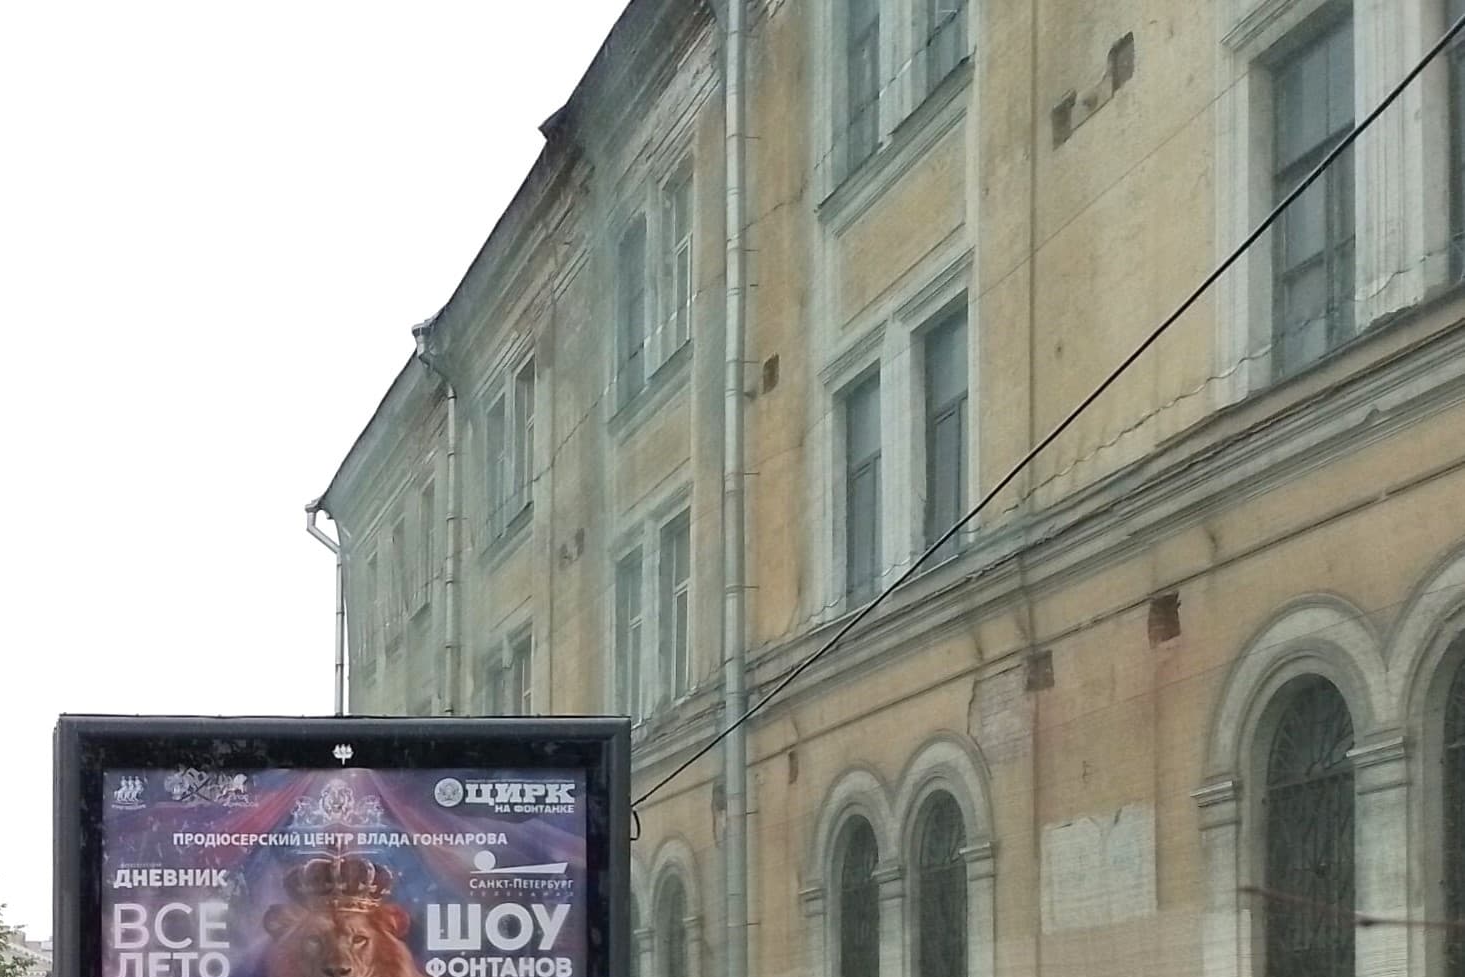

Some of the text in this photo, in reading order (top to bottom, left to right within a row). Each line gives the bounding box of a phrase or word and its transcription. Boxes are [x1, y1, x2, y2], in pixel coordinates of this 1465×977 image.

[465, 783, 575, 806] ЦИРК
[495, 804, 574, 813] НА ФОНТАНКЕ
[173, 832, 508, 848] ПРОДЮСЕРСКИЙ ЦЕНТР ВЛАДА ГОНЧАРОВА
[113, 868, 228, 889] ДНЕВНИК
[114, 902, 230, 949] ВСЕ
[427, 902, 572, 951] ШОУ
